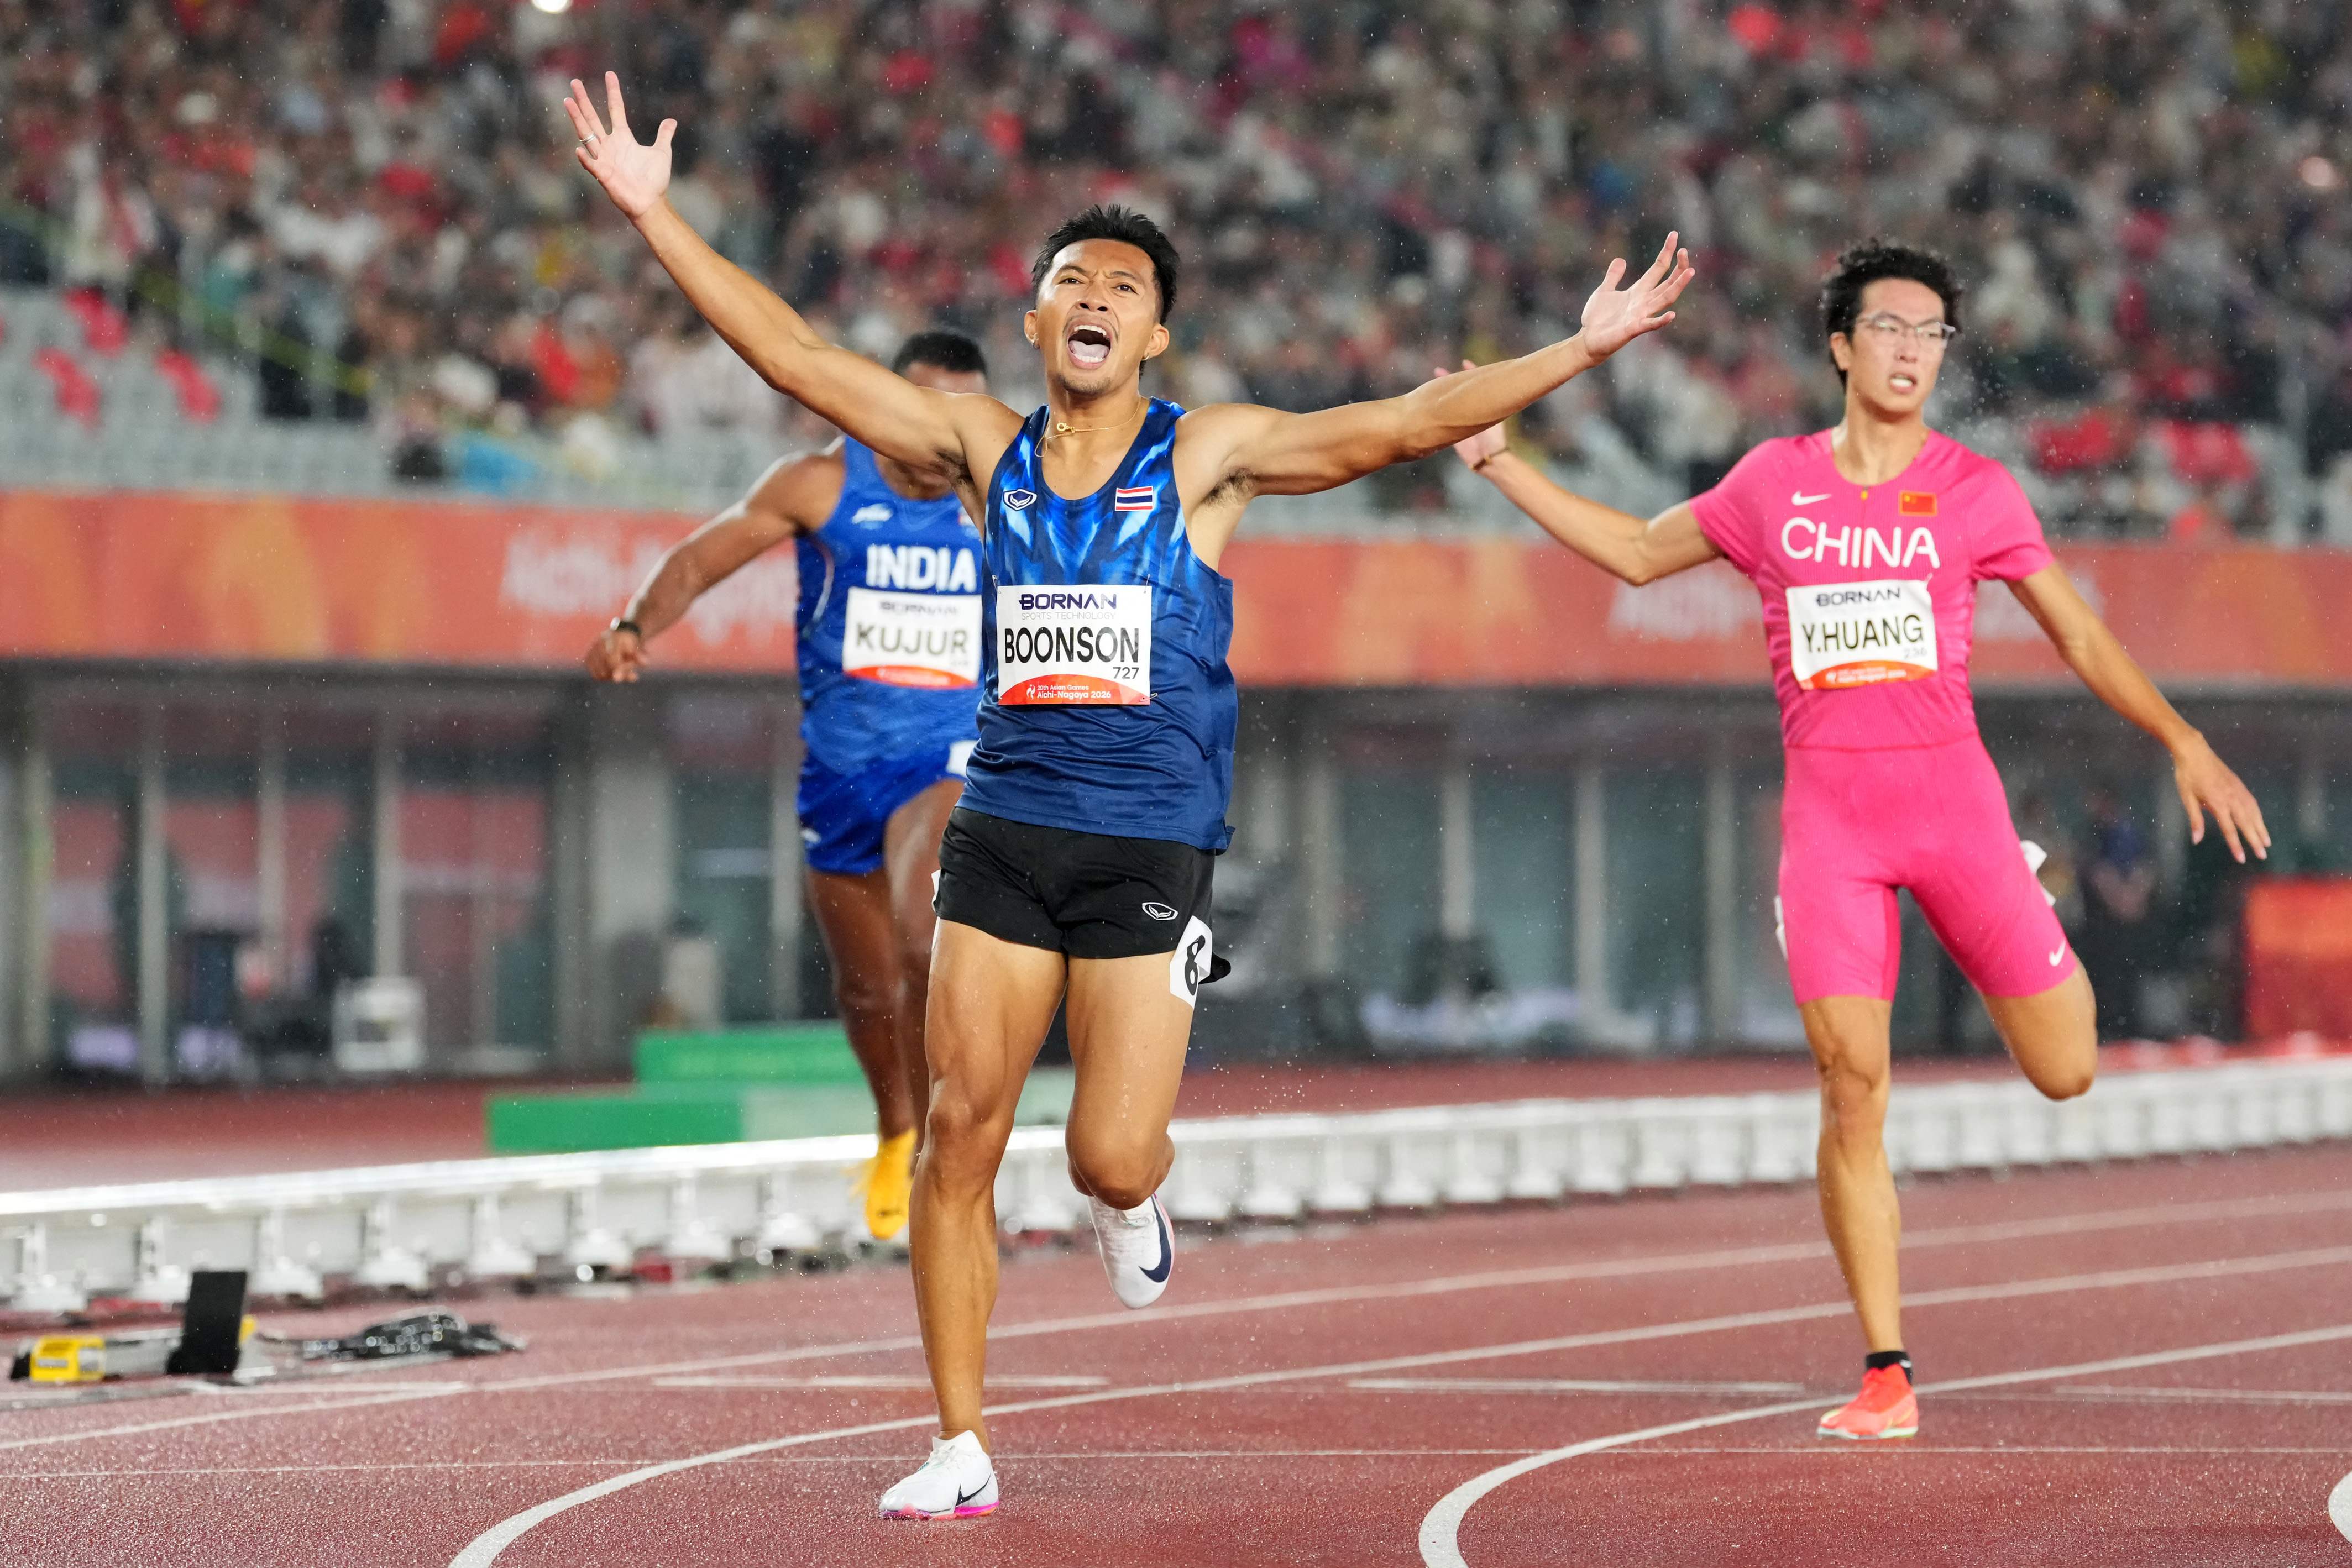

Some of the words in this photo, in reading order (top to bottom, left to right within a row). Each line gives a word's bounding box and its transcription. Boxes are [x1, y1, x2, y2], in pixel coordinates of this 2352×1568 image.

[1781, 517, 1940, 568] CHINA
[866, 544, 977, 592] INDIA
[1019, 593, 1117, 610] BORNAN
[1816, 588, 1900, 606] BORNAN
[1022, 612, 1052, 620] SPORTS
[1055, 611, 1116, 620] TECHNOLOGY
[856, 622, 969, 655] KUJUR
[1004, 626, 1139, 663] BOONSON
[1801, 615, 1923, 652] Y.HUANG
[1112, 667, 1140, 679] 727
[1036, 691, 1089, 700] Aichi-Nagoya
